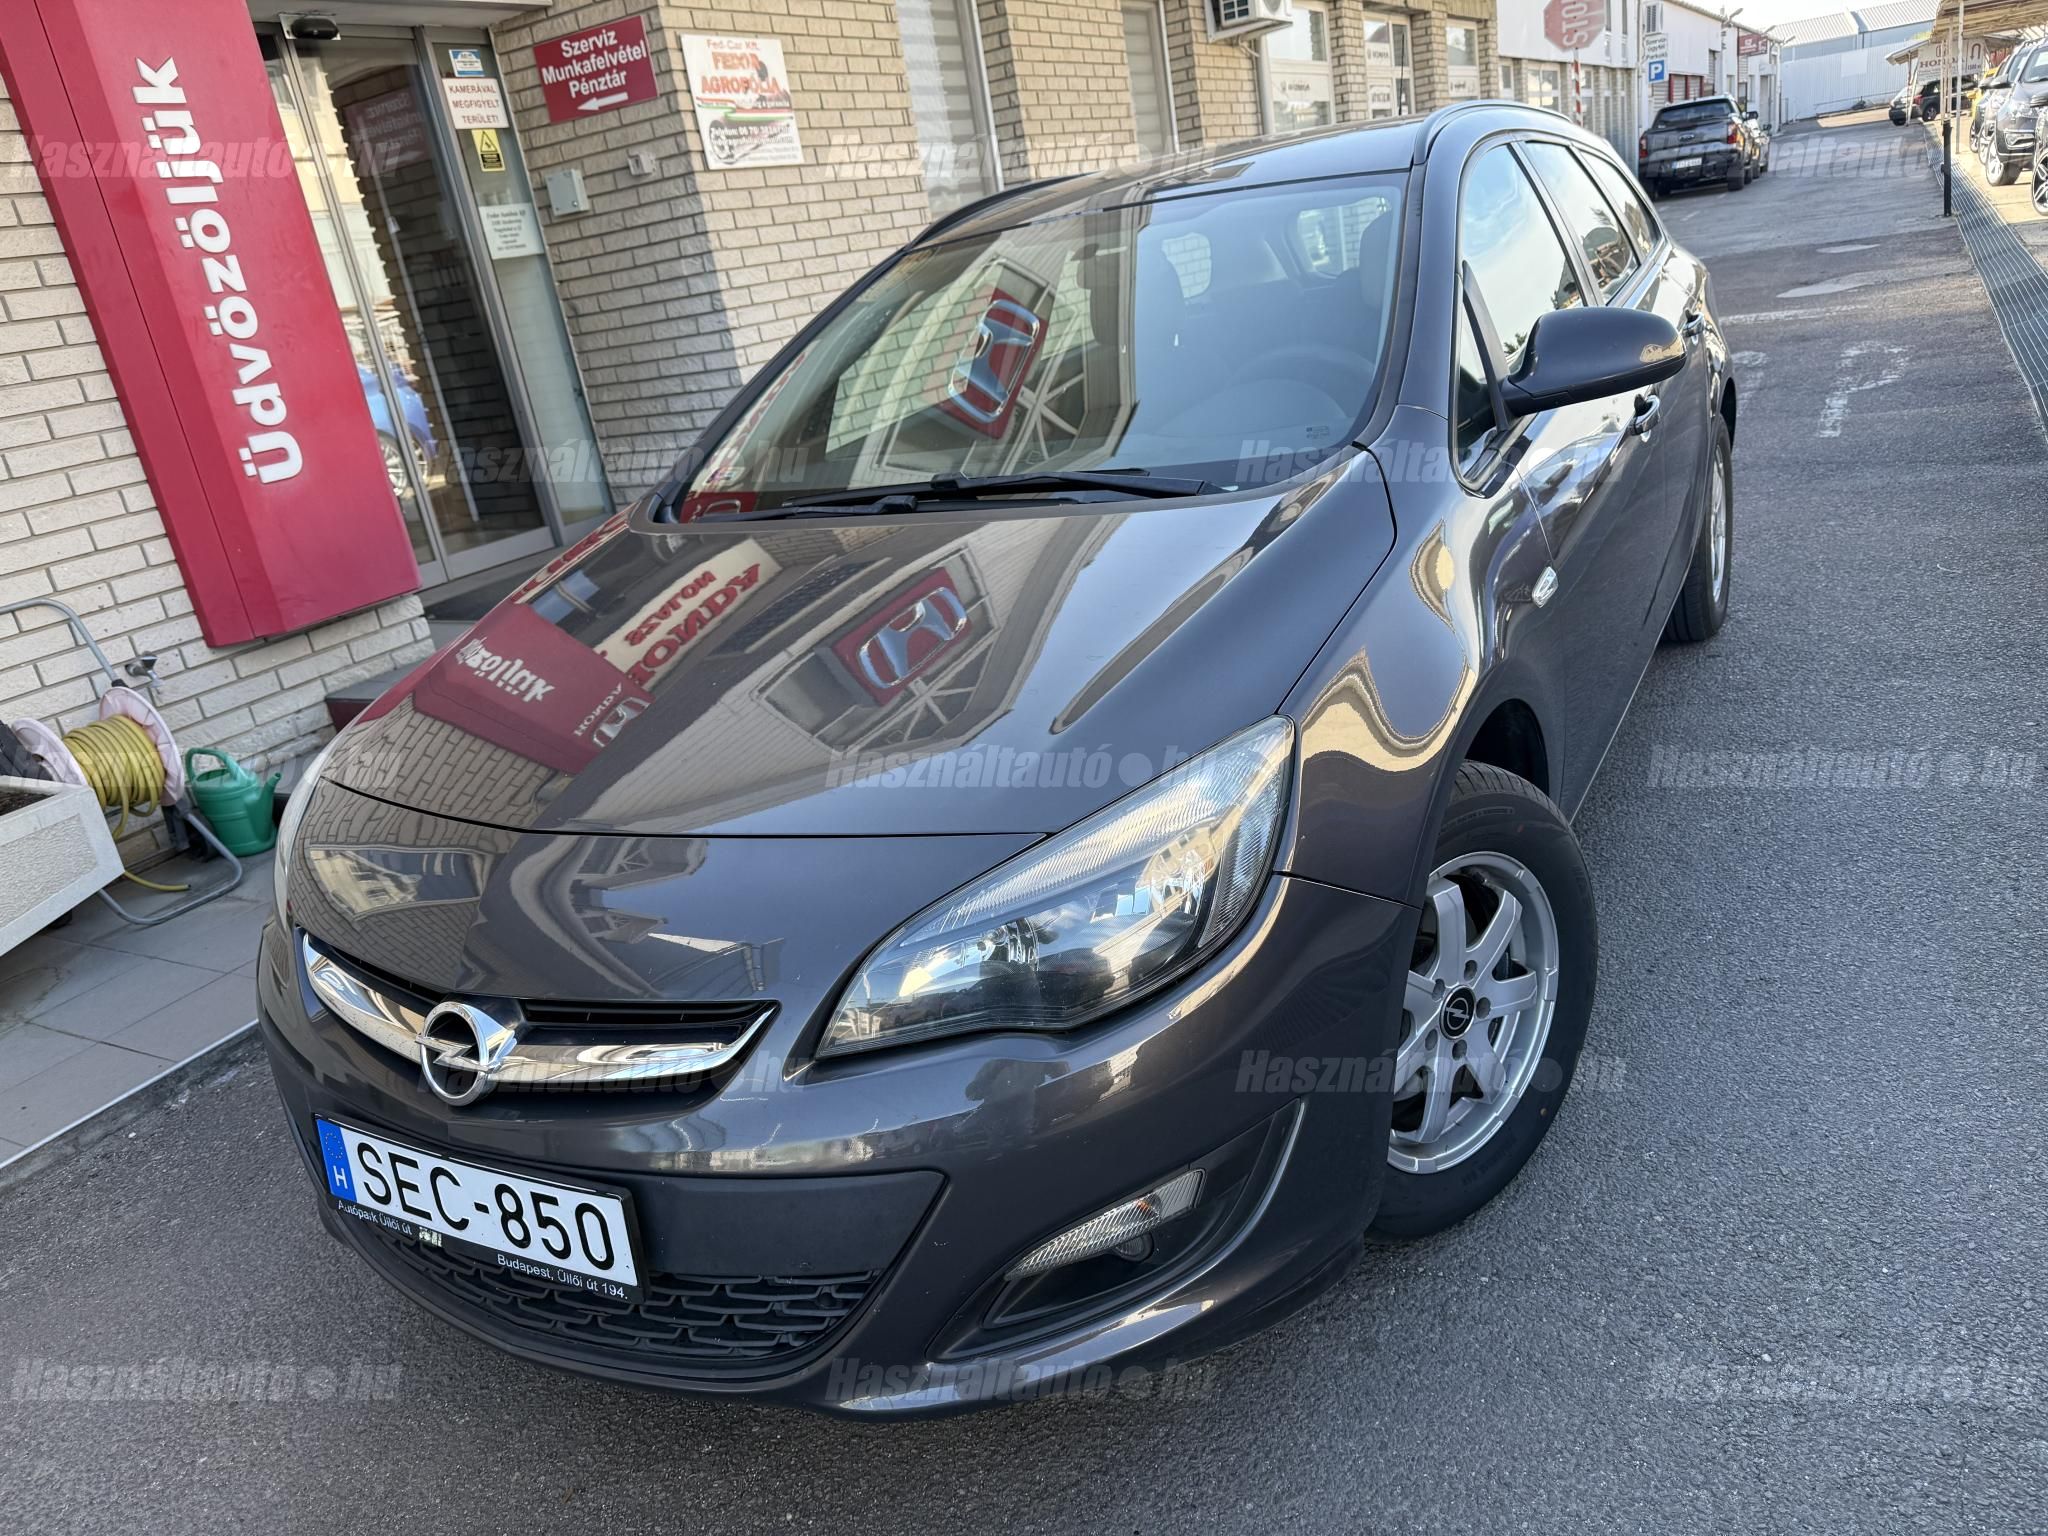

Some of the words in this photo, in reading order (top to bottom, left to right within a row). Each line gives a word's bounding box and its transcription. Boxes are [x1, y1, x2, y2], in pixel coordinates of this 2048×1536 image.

[1561, 0, 1589, 46] STO
[561, 29, 618, 58] Szerviz
[541, 40, 647, 86] Munkafelvétel
[1650, 63, 1662, 79] P
[449, 83, 496, 95] KAMERÁVAL
[569, 70, 627, 99] Pénztár
[452, 99, 499, 109] MEGFIGYELT
[133, 56, 304, 484] Üdvözöljük
[333, 1166, 349, 1190] H
[357, 1142, 615, 1271] SEC-850
[497, 1254, 554, 1281] Budapest,
[557, 1268, 583, 1288] Üllői
[586, 1277, 600, 1292] út
[601, 1281, 629, 1300] 194.
